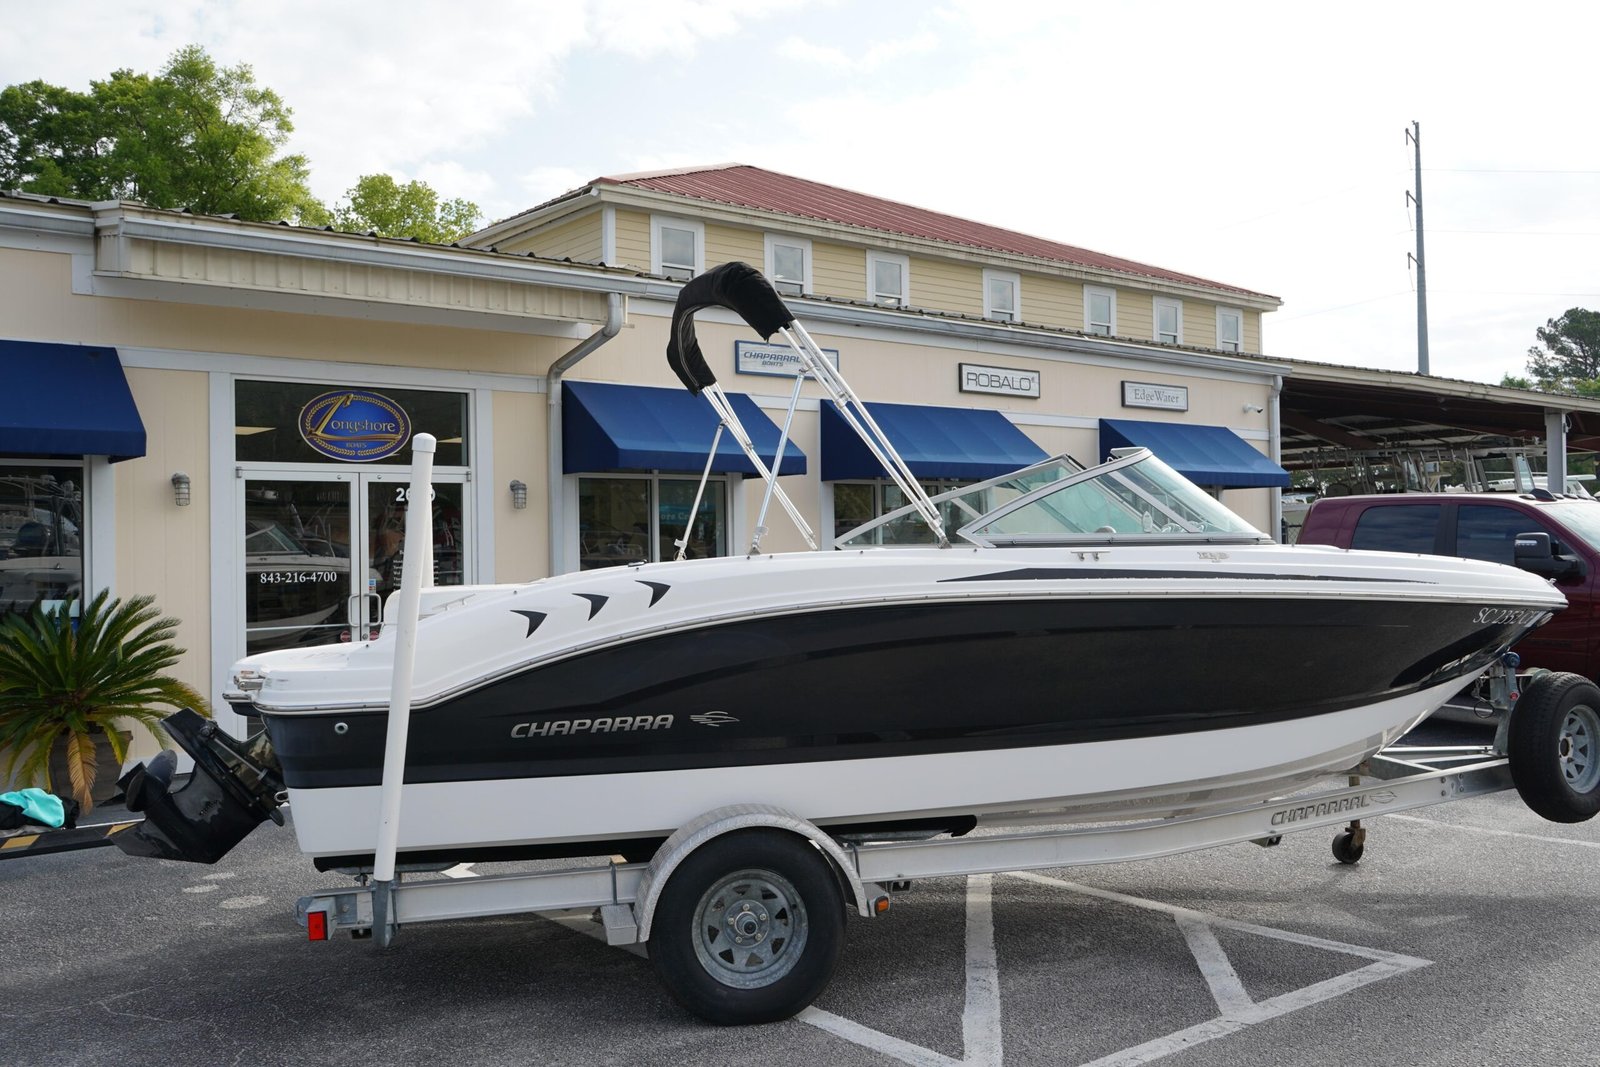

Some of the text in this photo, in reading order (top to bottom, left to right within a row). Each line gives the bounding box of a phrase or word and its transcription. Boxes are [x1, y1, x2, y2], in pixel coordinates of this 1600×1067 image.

[743, 351, 801, 363] CHAPARRAL
[1134, 388, 1180, 403] EdgeWater
[306, 393, 401, 441] Longshore
[260, 571, 337, 584] 843-216-4700
[1472, 607, 1498, 624] SC
[511, 714, 674, 739] CHAPARRA
[1271, 794, 1370, 826] CHAPARRAL
